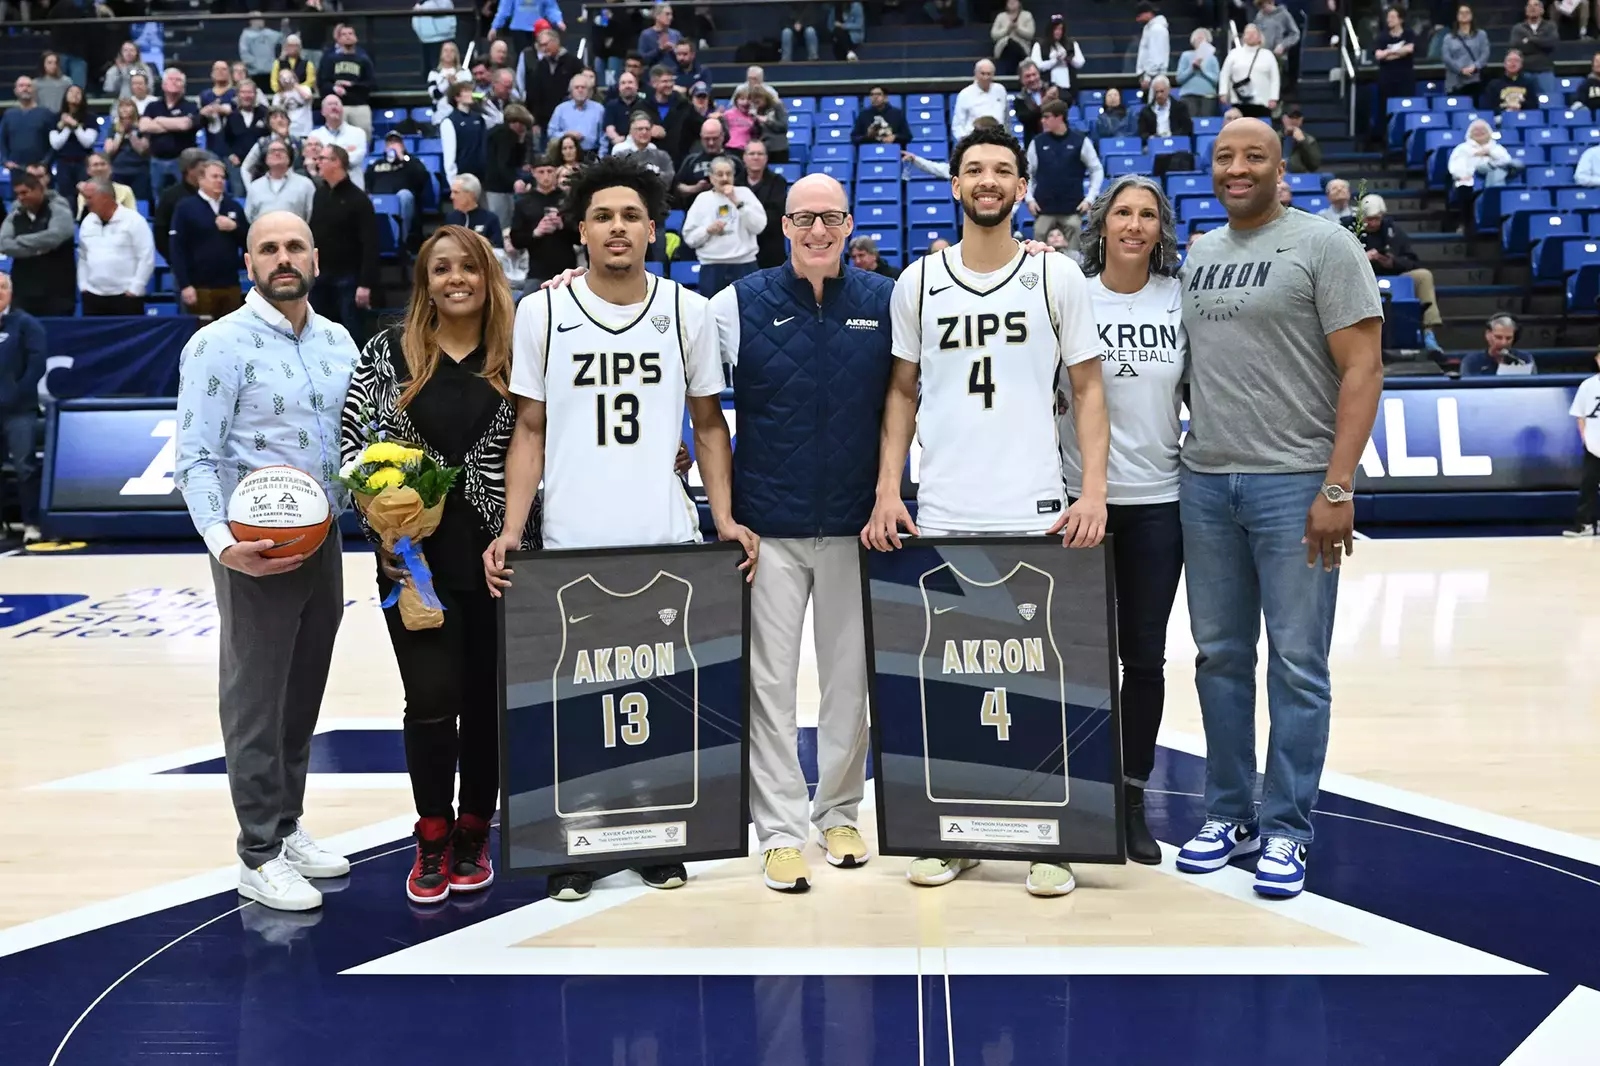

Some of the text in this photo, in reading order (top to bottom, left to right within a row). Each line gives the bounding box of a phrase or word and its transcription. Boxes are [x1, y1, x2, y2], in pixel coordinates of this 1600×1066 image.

[1188, 261, 1272, 292] AKRON
[845, 318, 879, 327] AKRON
[937, 311, 1028, 350] ZIPS
[572, 351, 662, 387] ZIPS
[968, 355, 996, 410] 4
[1115, 363, 1139, 377] A
[596, 392, 640, 446] 13
[291, 484, 318, 497] POINTS
[573, 641, 676, 685] AKRON
[942, 637, 1046, 675] AKRON
[602, 691, 650, 749] 13
[980, 686, 1012, 742] 4
[574, 836, 592, 847] A
[947, 822, 964, 833] A
